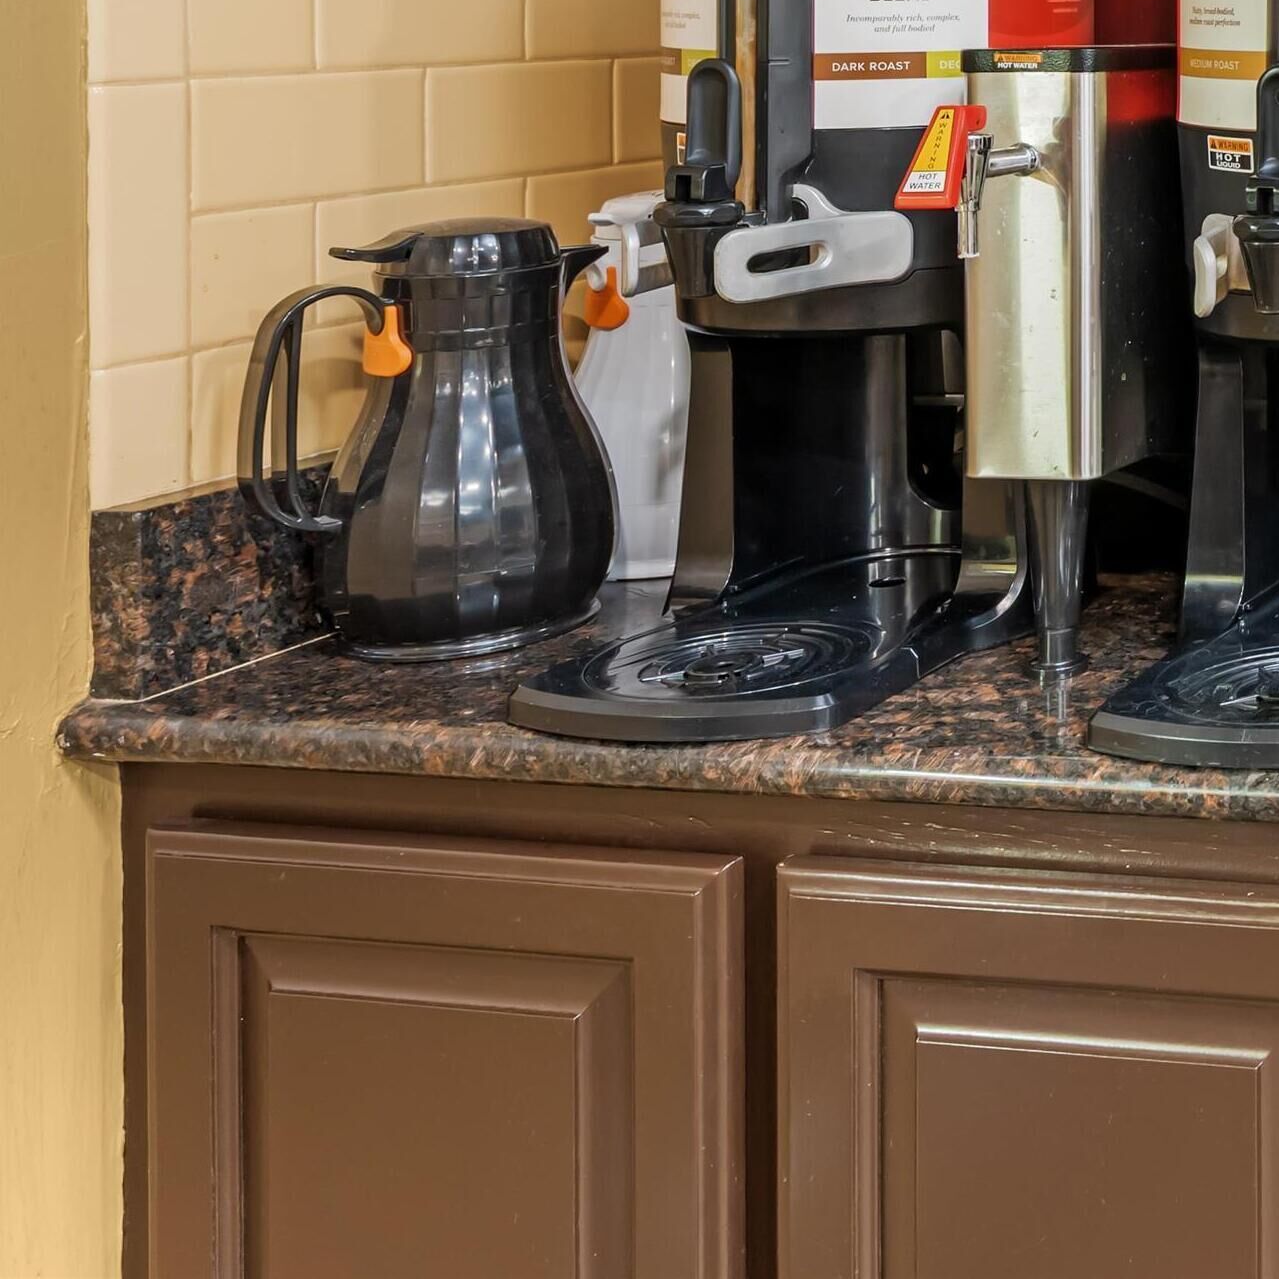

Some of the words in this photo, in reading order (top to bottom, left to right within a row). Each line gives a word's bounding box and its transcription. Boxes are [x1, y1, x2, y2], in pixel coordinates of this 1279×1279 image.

[846, 13, 904, 24] Incomparably
[926, 12, 961, 23] complex,
[891, 24, 907, 35] full
[908, 23, 936, 33] bodied
[831, 62, 866, 72] DARK
[869, 60, 912, 71] ROAST
[1214, 60, 1240, 71] ROAST
[927, 122, 947, 170] WARNING
[1217, 140, 1249, 152] WARNING
[1215, 153, 1241, 162] HOT
[1216, 161, 1241, 169] LIQUID
[918, 173, 938, 181] HOT
[909, 182, 942, 190] WATER
